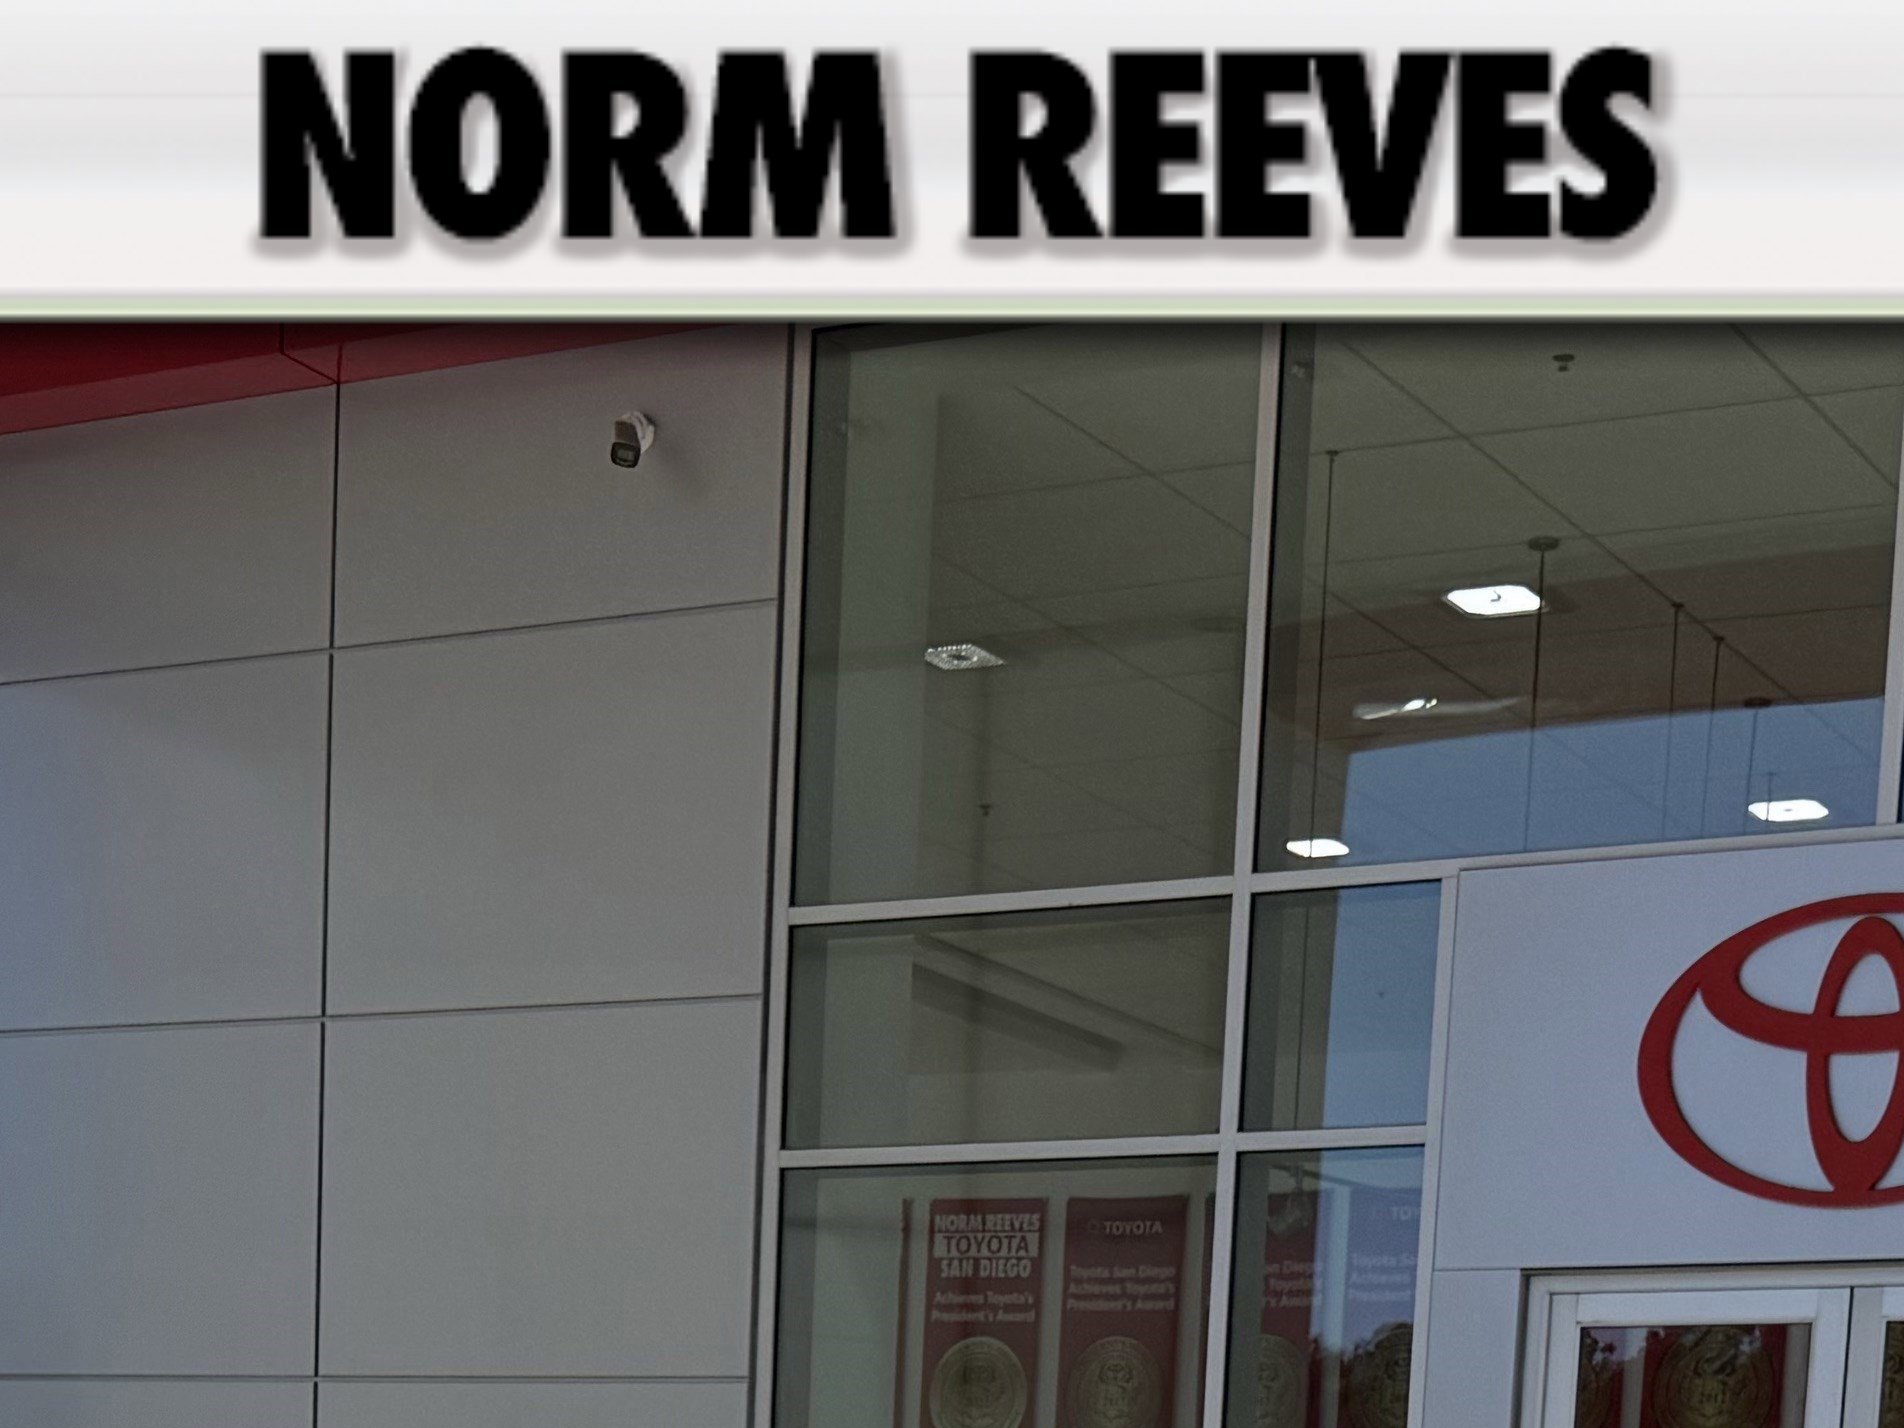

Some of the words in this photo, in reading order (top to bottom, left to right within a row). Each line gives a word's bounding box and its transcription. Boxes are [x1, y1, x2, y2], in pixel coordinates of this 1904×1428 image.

[935, 1213, 982, 1232] NORM
[984, 1212, 1040, 1231] REEVES
[1104, 1219, 1163, 1235] TOYOTA
[943, 1235, 1029, 1254] TOYOTA
[940, 1259, 975, 1278] SAN
[979, 1259, 1032, 1278] DIEGO
